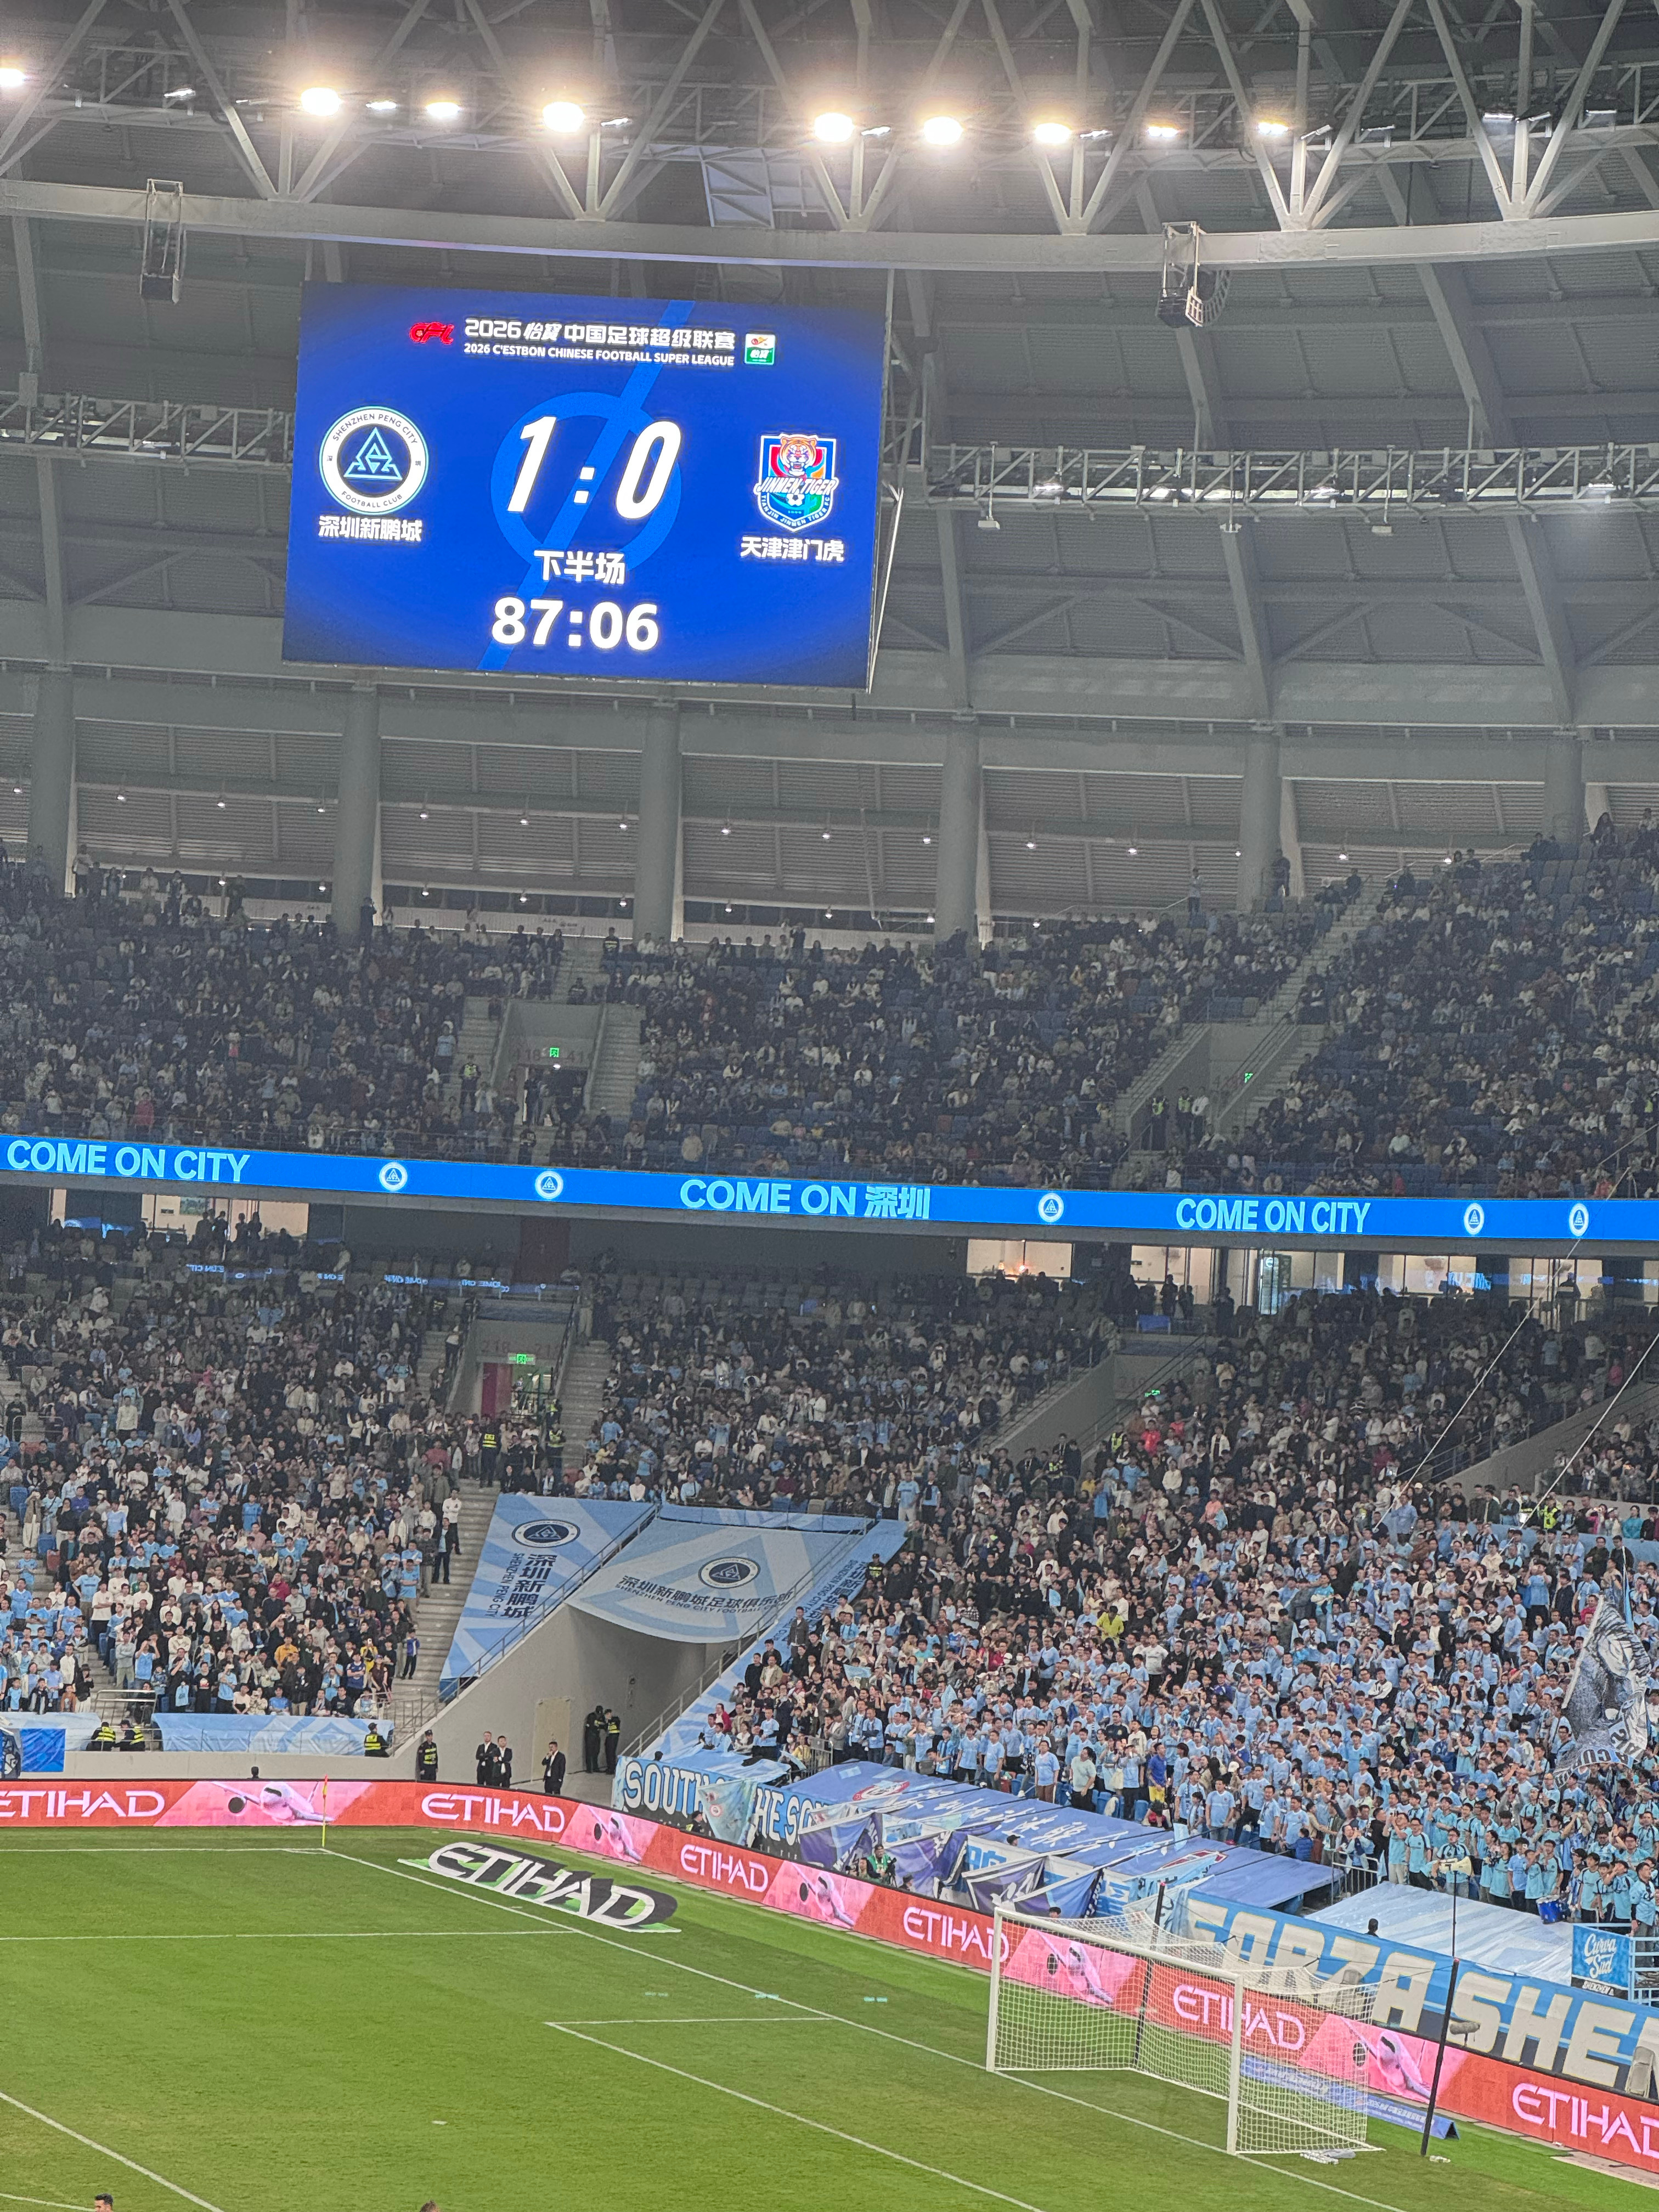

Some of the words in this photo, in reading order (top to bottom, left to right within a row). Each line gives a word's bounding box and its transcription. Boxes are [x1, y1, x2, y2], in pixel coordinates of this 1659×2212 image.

[465, 319, 521, 338] 2026
[564, 323, 735, 349] 中国足球超级联赛
[464, 343, 490, 354] 2026
[492, 345, 545, 357] C'ESTBON
[548, 347, 593, 360] CHINESE
[595, 349, 652, 363] FOOTBALL
[653, 353, 689, 364] SUPER
[691, 354, 735, 366] LEAGUE
[332, 413, 375, 441] SHENZHEN
[377, 413, 402, 427] PENG
[403, 426, 418, 444] CITY
[507, 416, 557, 512] 1
[616, 420, 681, 520] 0
[341, 491, 381, 508] FOOTBALL
[383, 494, 403, 506] CLUB
[318, 515, 423, 542] 深圳新鹏城
[740, 535, 845, 562] 天津津门虎
[534, 549, 625, 585] 下半场
[492, 596, 658, 651] 87:06
[7, 1140, 107, 1174] COME
[115, 1147, 165, 1179] ON
[174, 1151, 250, 1183] CITY
[680, 1178, 791, 1214] COME
[800, 1184, 856, 1216] ON
[864, 1186, 931, 1220] 深圳
[1176, 1197, 1258, 1230] COME
[1264, 1200, 1305, 1232] ON
[1311, 1201, 1371, 1233] CITY
[500, 1553, 524, 1584] SHENZHEN
[500, 1554, 557, 1618] 深圳新鹏城
[492, 1585, 510, 1602] PENG
[615, 1584, 663, 1602] SHENZHEN
[665, 1599, 690, 1609] PENG
[421, 1793, 565, 1833] ETIHAD
[428, 1842, 656, 1926] ETIHAD
[680, 1843, 768, 1892] ETIHAD
[903, 1906, 1009, 1962] ETIHAD
[1584, 1933, 1617, 1956] Curva
[1187, 1899, 1436, 2032] FORZA
[1589, 1954, 1614, 1979] Sud
[1173, 1983, 1306, 2050] ETIHAD
[1512, 2083, 1659, 2158] ETIHAD
